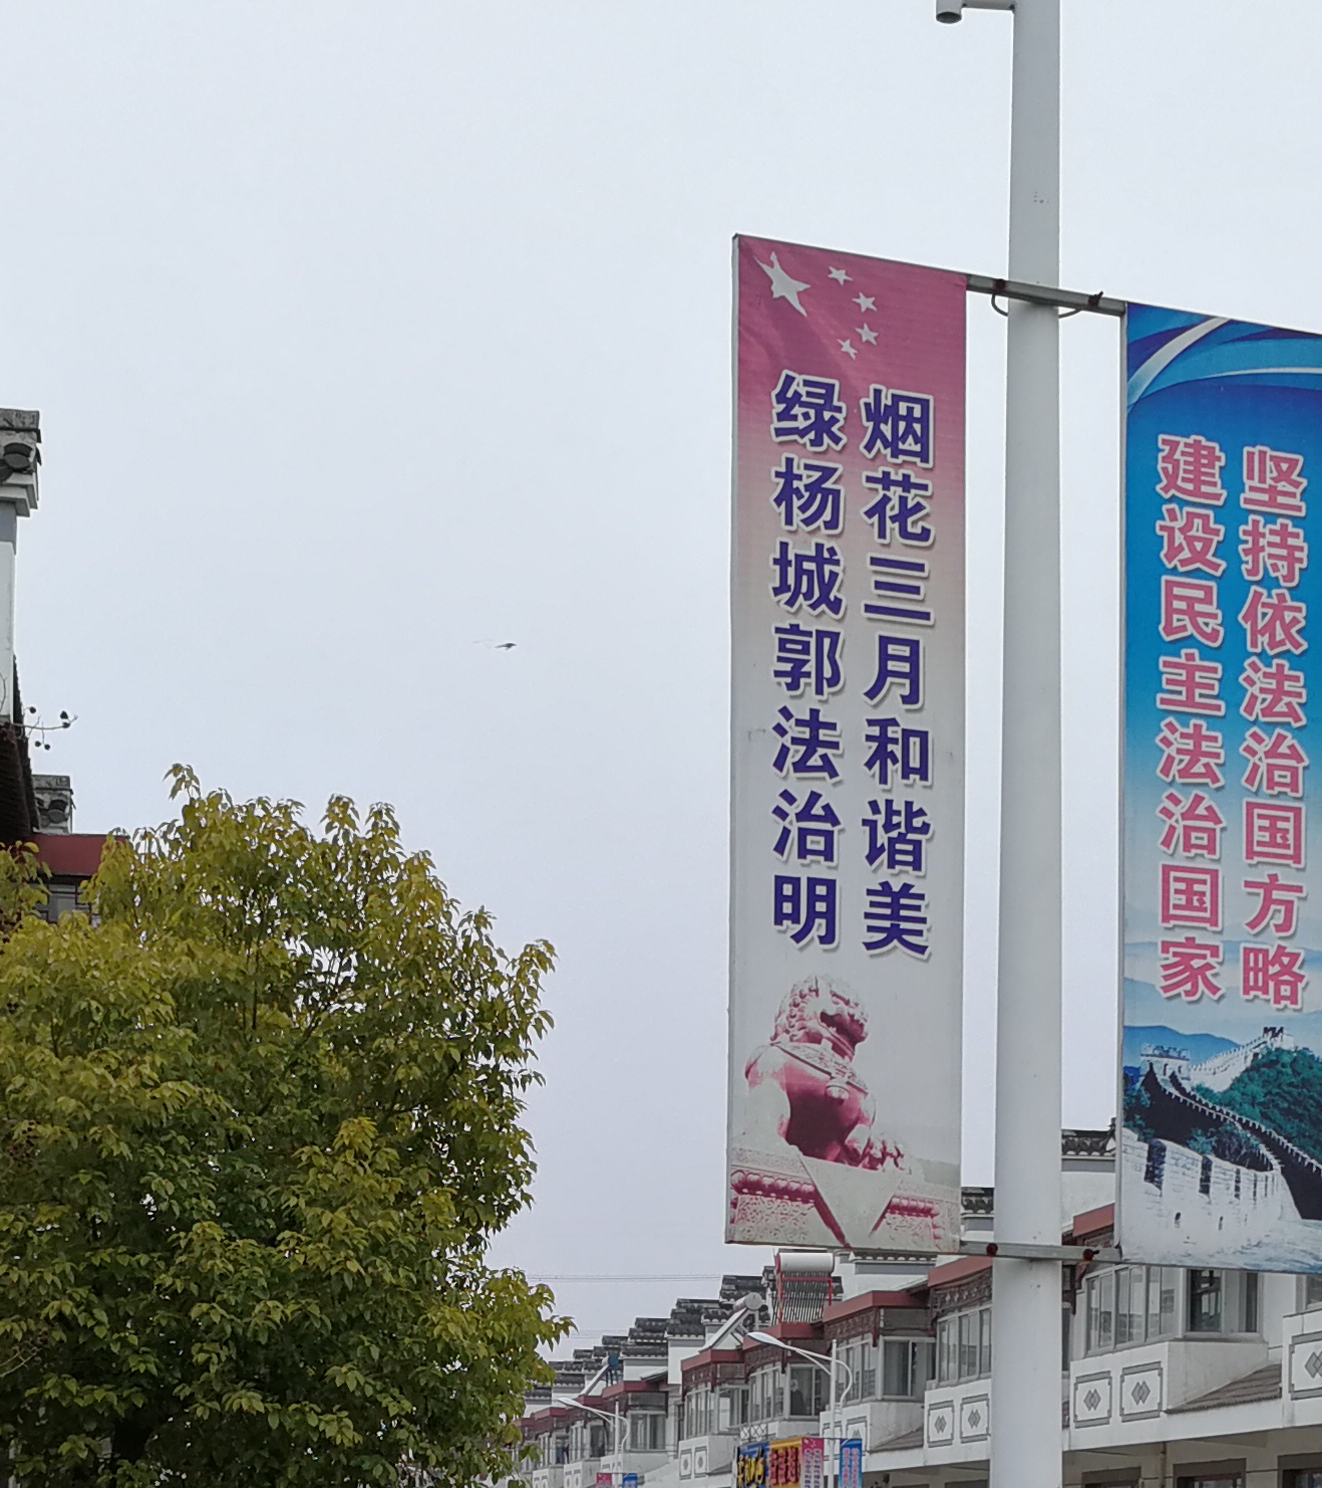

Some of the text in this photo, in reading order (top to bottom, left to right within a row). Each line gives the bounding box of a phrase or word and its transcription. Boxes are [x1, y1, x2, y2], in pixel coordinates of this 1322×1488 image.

[772, 372, 844, 945] 绿杨城郭法治明
[863, 385, 933, 958] 烟花三月和谐美
[1157, 435, 1226, 1001] 建设民主法治国家
[1240, 446, 1308, 1009] 坚持依法治国方略
